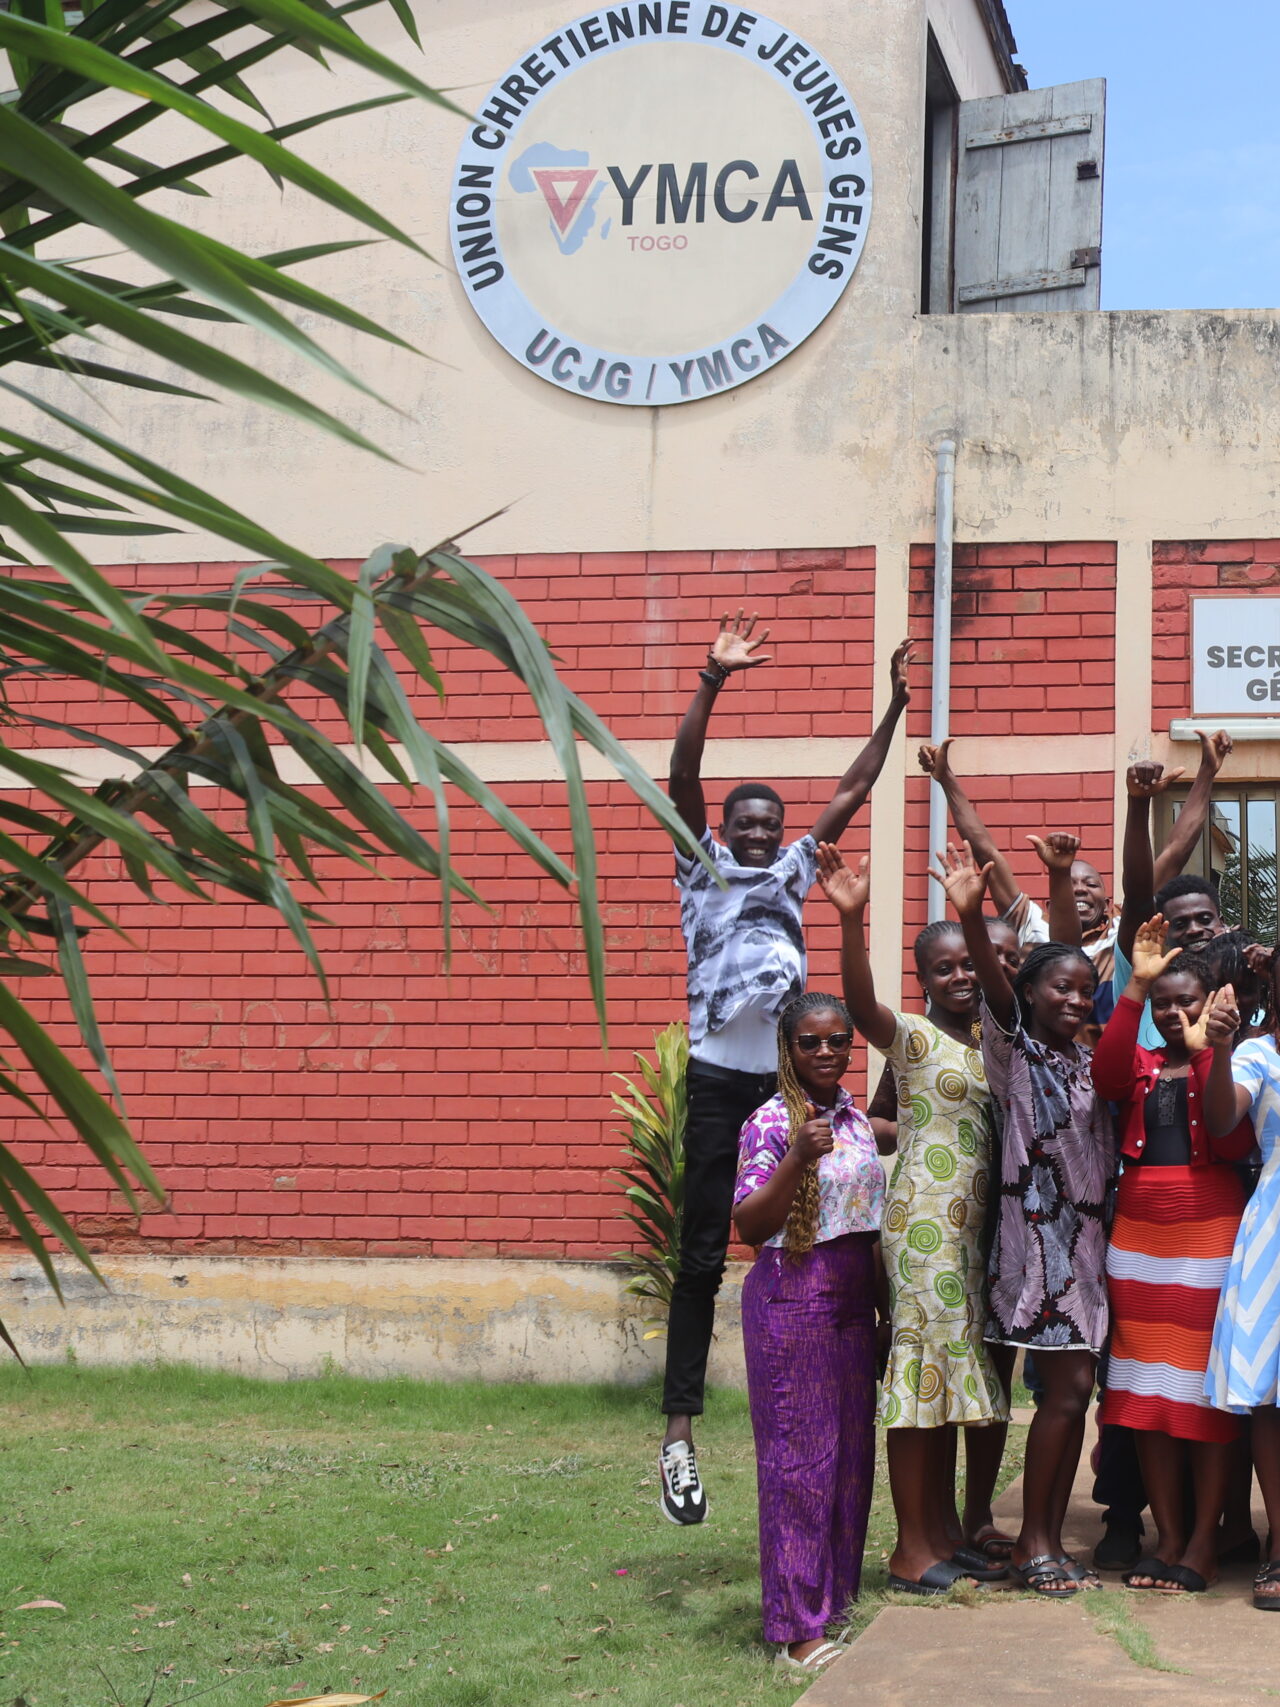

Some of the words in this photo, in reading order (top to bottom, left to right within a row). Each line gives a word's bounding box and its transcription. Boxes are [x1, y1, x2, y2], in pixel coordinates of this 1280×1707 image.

[702, 4, 757, 48] DE
[471, 0, 691, 150] CHRETIENNE
[757, 32, 862, 161] JEUNES
[456, 164, 505, 291] UNION
[606, 159, 814, 226] YMCA
[807, 174, 866, 280] GENS
[627, 235, 688, 252] TOGO
[524, 328, 633, 398] UCJG
[669, 322, 790, 397] YMCA
[179, 1001, 400, 1071] 2022
